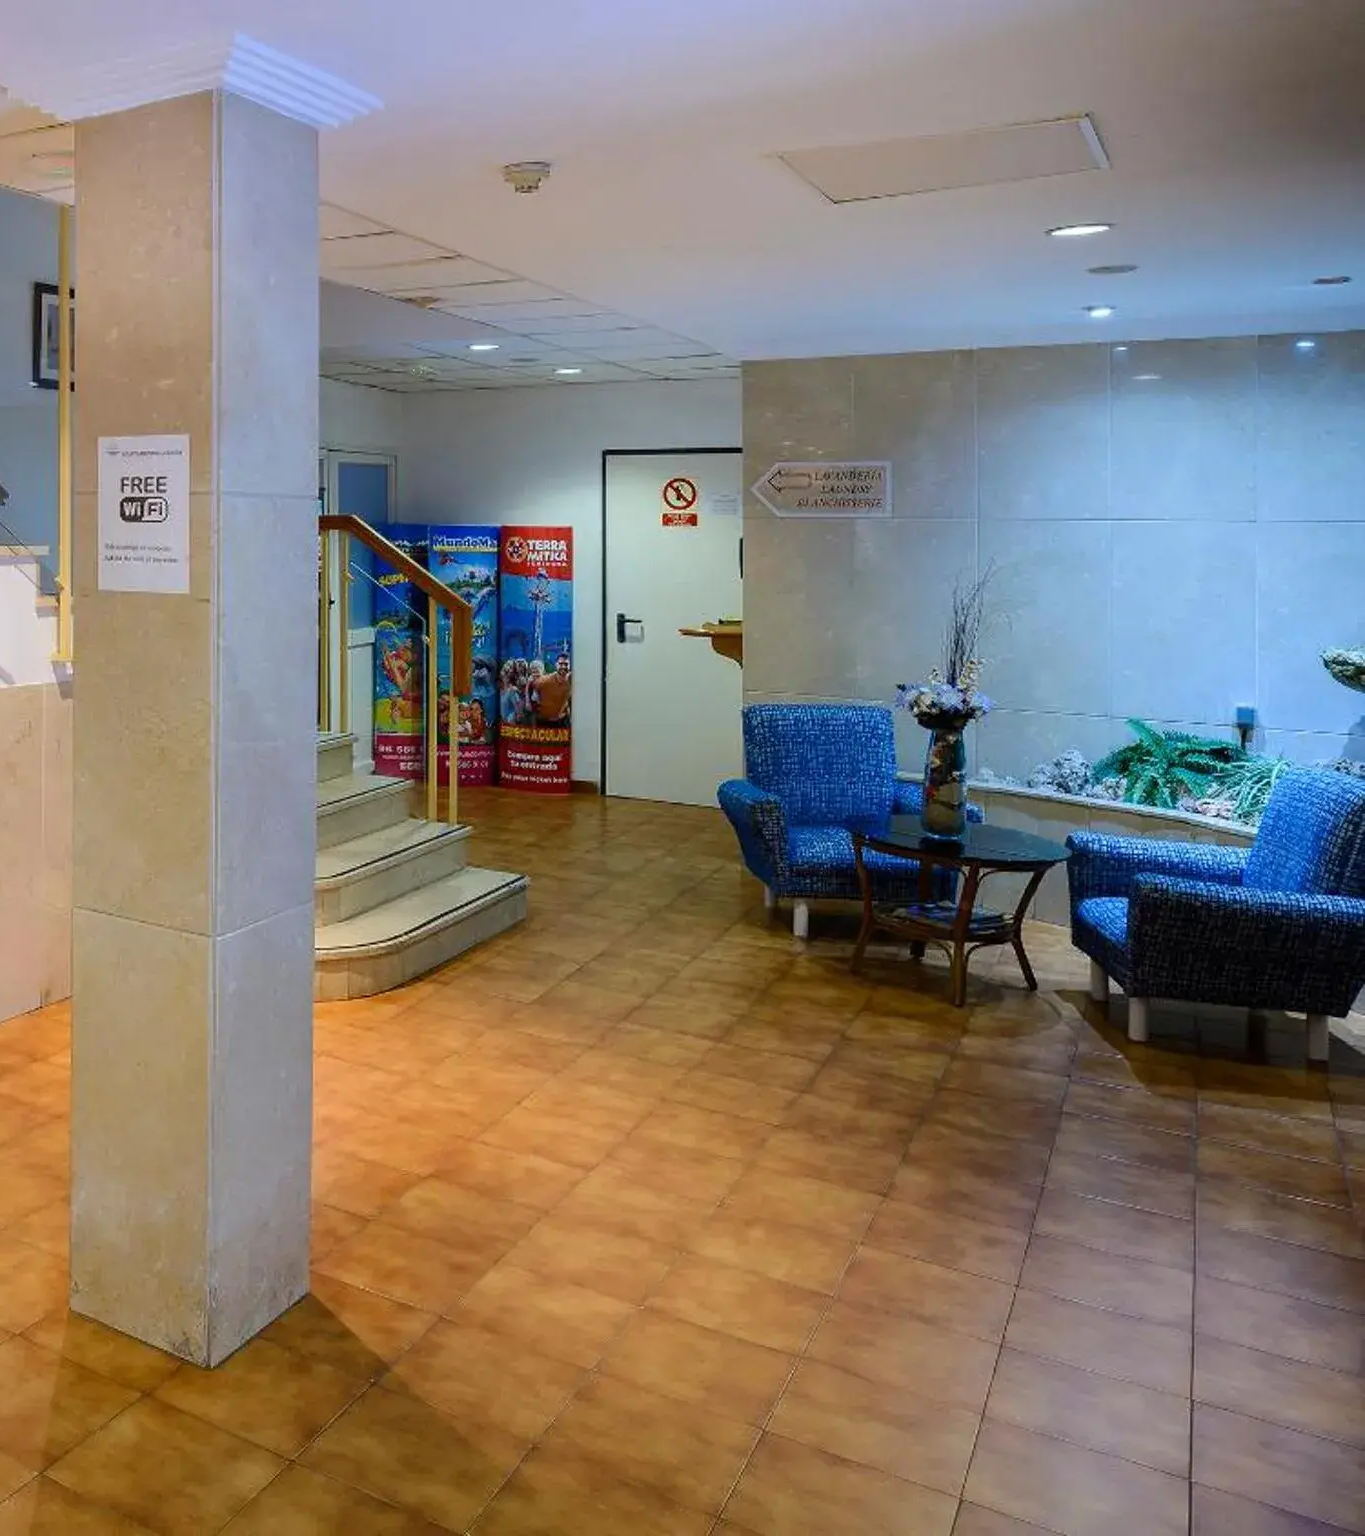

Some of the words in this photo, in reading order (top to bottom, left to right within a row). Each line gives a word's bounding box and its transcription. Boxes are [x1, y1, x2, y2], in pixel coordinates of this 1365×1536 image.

[120, 476, 168, 494] FREE
[527, 540, 567, 551] TERRA
[500, 725, 569, 742] ESPECTACULAR
